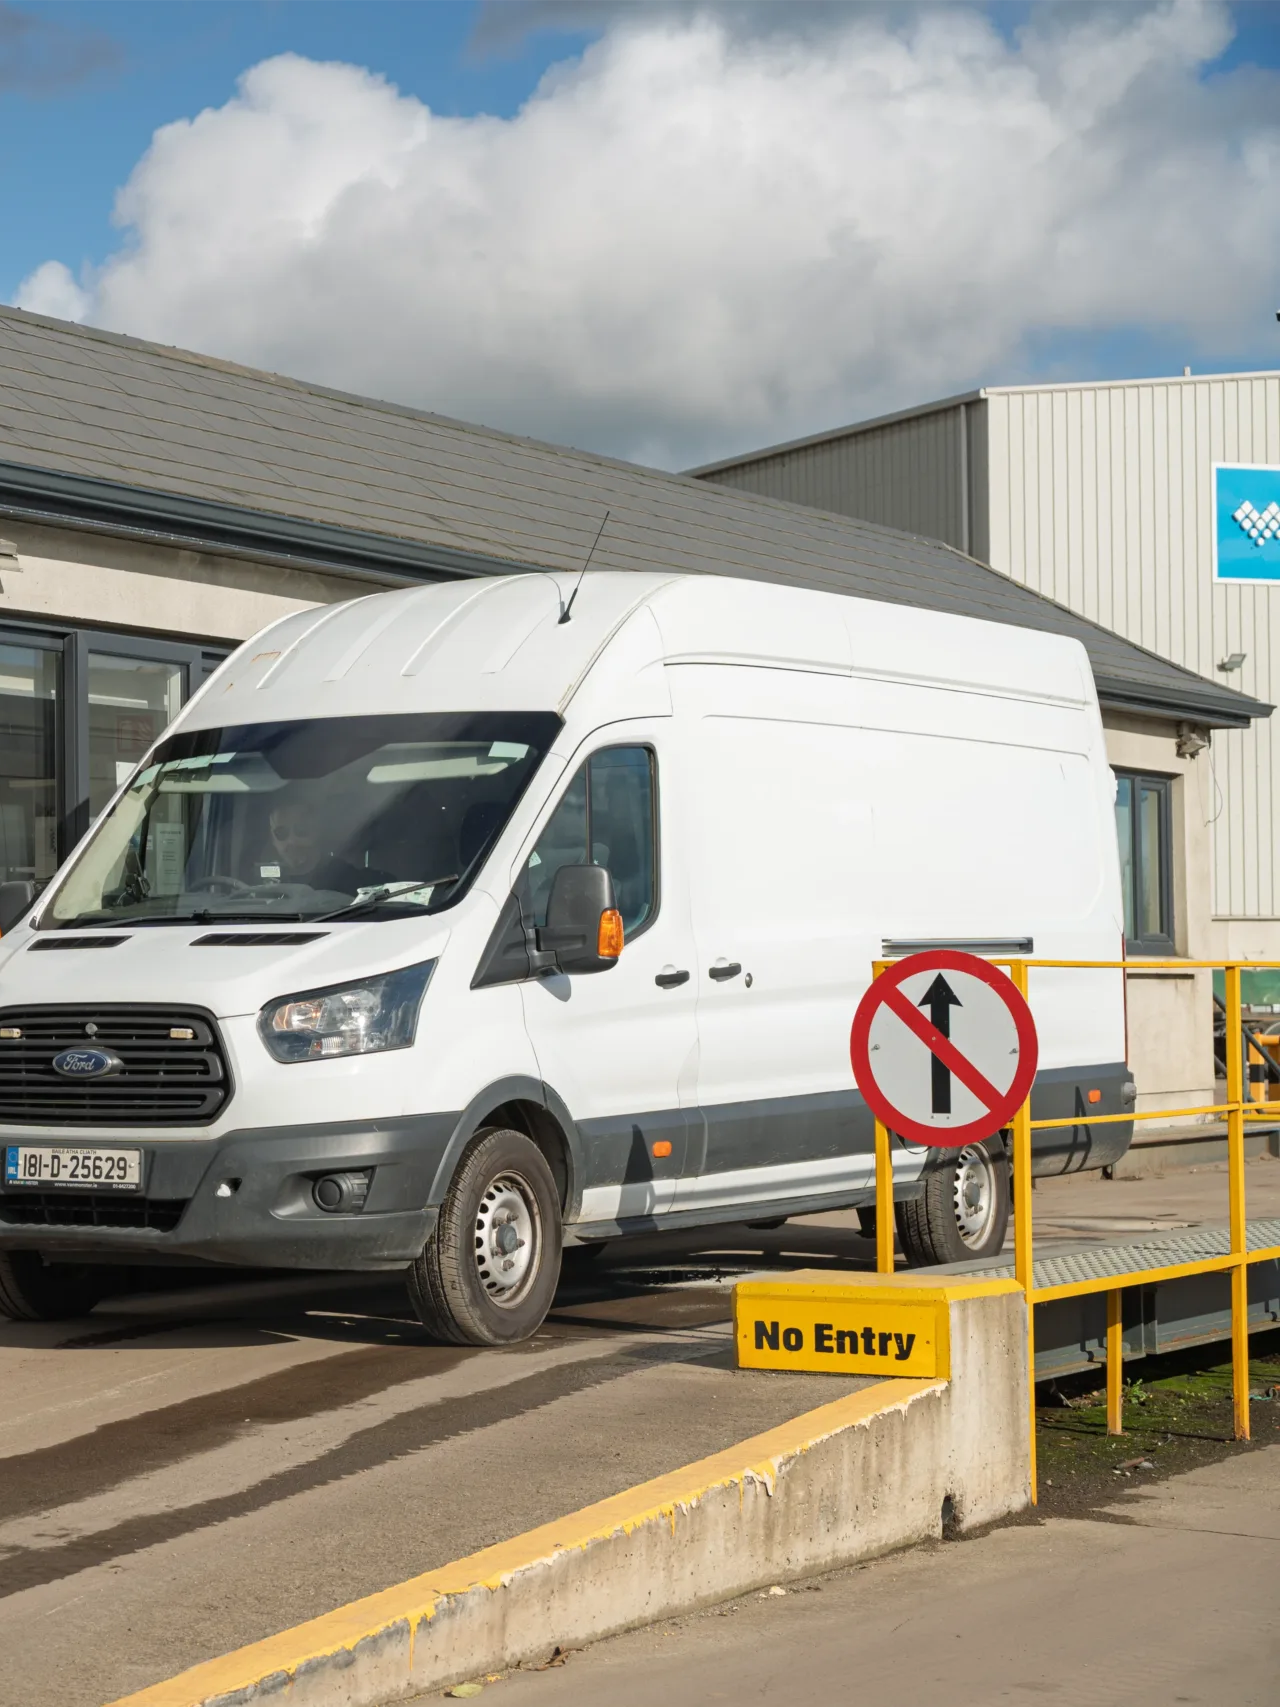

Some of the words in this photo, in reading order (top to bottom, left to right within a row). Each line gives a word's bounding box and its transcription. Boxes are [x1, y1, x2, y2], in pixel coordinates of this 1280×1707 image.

[63, 1053, 96, 1070] Ford
[23, 1153, 128, 1181] 181-D-25629
[754, 1320, 804, 1352] No
[814, 1323, 916, 1361] Entry
